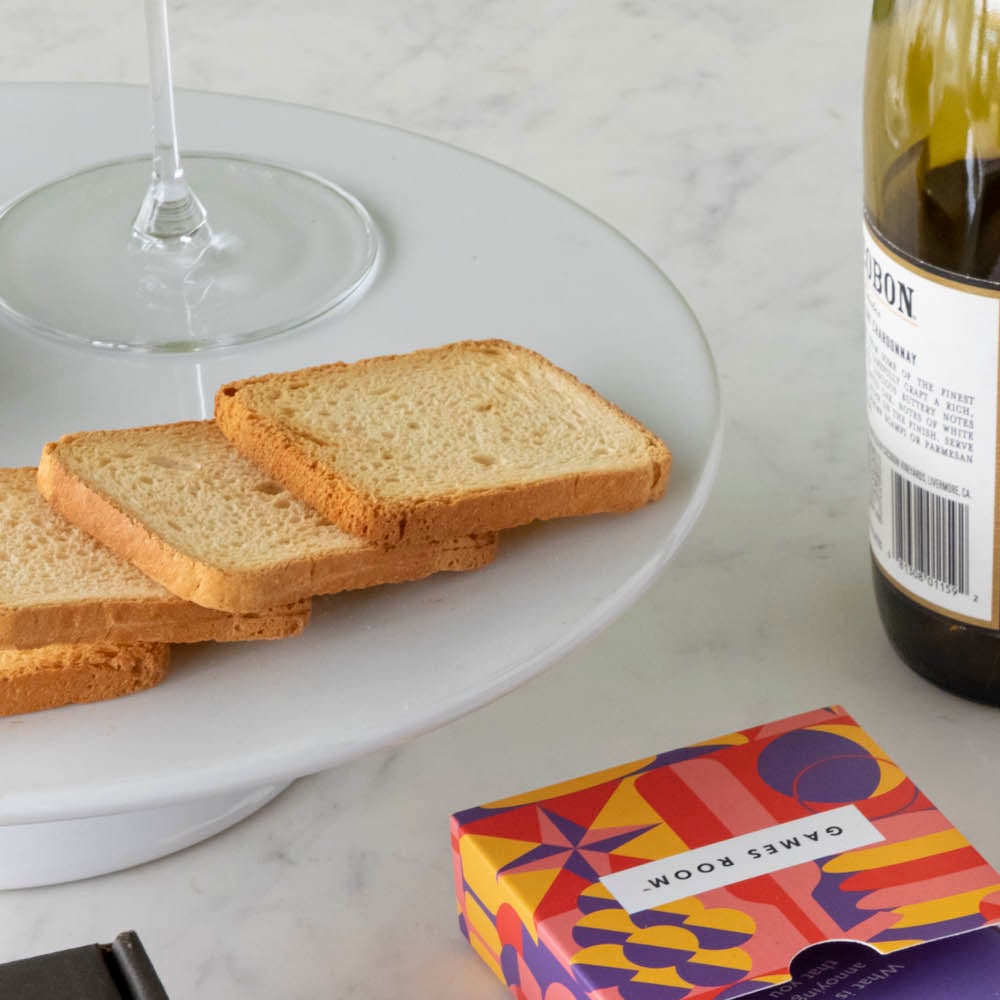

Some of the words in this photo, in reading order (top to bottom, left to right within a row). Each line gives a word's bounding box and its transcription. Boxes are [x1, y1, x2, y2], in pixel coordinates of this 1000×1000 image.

[917, 377, 934, 393] THE
[941, 387, 975, 406] FINEST
[934, 397, 940, 407] A
[902, 392, 937, 417] BUTTERY
[943, 412, 974, 430] NOTES
[926, 418, 938, 429] OF
[942, 423, 974, 441] WHITE
[924, 440, 974, 464] PARMESAN
[944, 436, 974, 453] SERVE
[747, 825, 844, 860] GAMES
[801, 958, 839, 979] that
[850, 962, 905, 991] What
[769, 978, 803, 1000] you
[835, 988, 857, 1000] is
